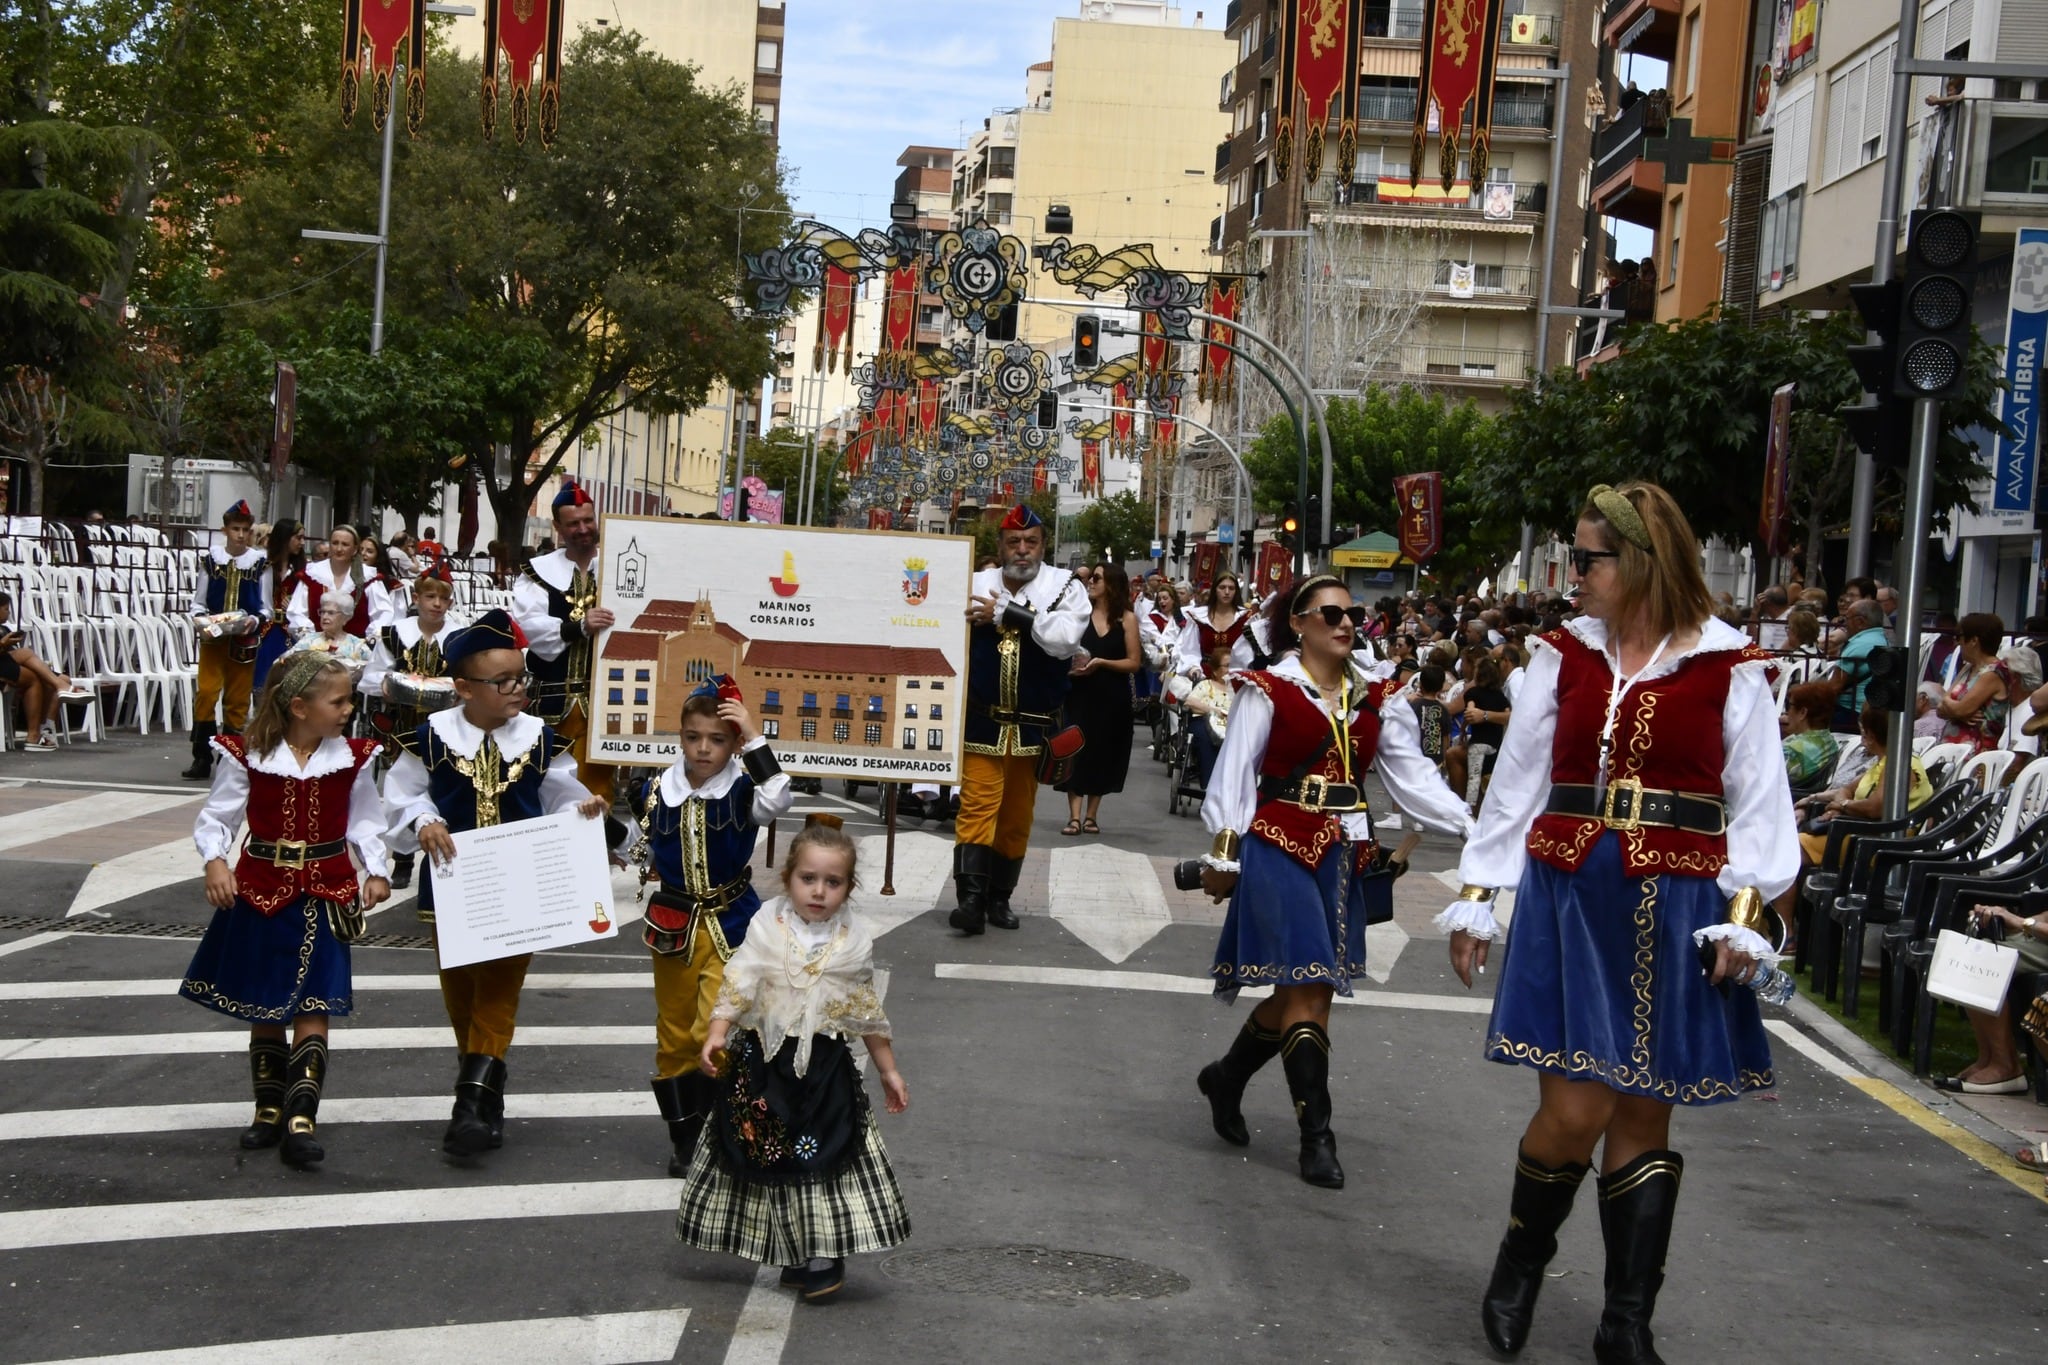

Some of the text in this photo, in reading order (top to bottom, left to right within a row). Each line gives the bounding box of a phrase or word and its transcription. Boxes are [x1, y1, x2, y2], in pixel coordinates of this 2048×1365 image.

[2013, 337, 2037, 404] FIBRA
[2007, 407, 2030, 501] AVANZA
[759, 600, 811, 613] MARINOS
[750, 614, 815, 627] CORSARIOS
[890, 616, 940, 629] VILLENA
[601, 741, 952, 772] ASILO DE LAS LOS ANCIANOS DESAMPARADOS
[1963, 963, 2000, 978] SENTO
